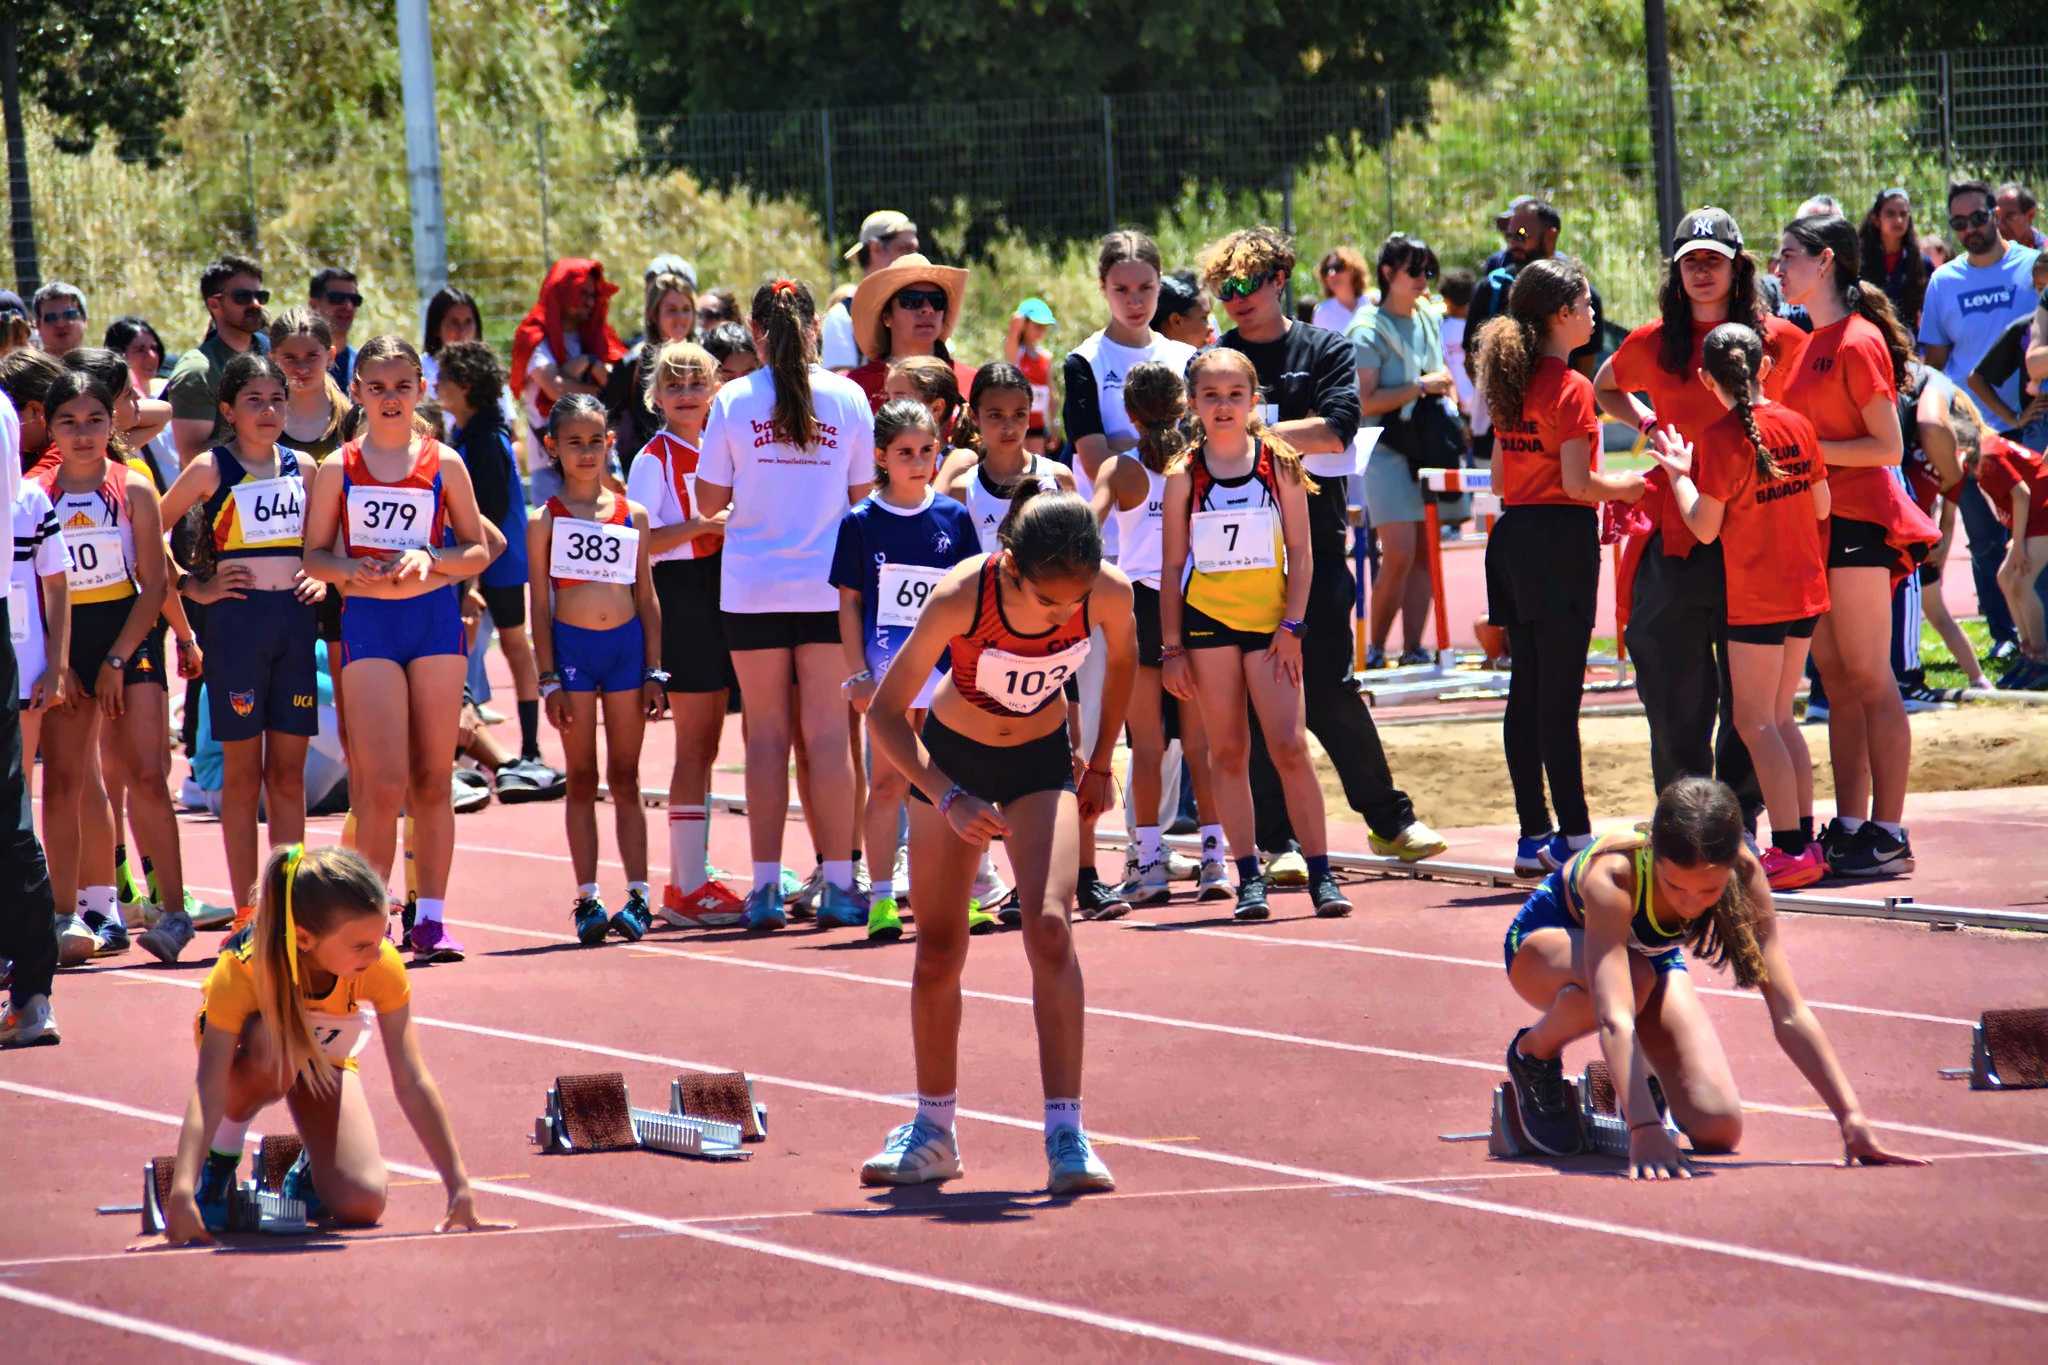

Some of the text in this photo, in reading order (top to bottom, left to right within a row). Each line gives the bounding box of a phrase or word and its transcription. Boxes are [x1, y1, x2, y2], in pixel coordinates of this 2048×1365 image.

[1693, 217, 1714, 236] NY
[255, 493, 300, 521] 644
[363, 501, 416, 530] 379
[567, 533, 620, 563] 383
[1223, 524, 1239, 551] 7
[896, 580, 937, 608] 69
[1005, 665, 1068, 696] 103
[293, 695, 313, 708] UCA
